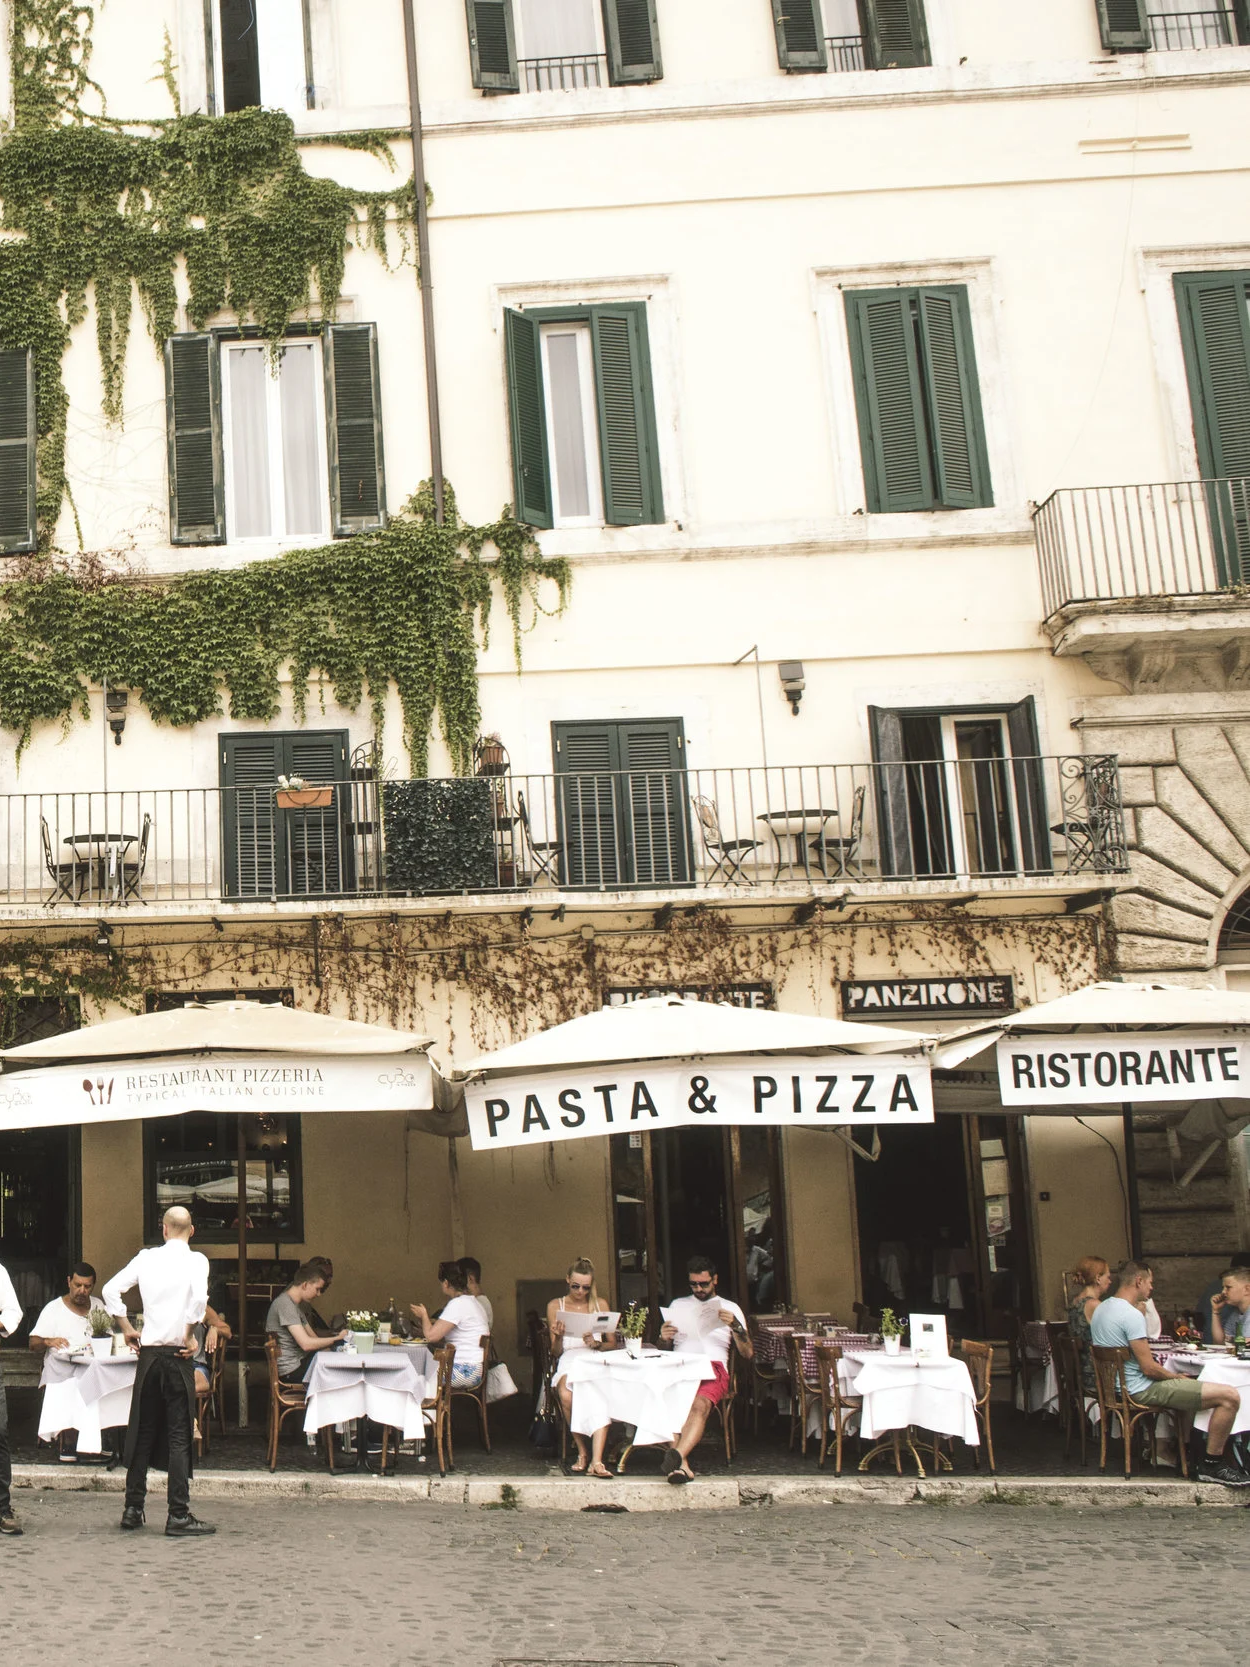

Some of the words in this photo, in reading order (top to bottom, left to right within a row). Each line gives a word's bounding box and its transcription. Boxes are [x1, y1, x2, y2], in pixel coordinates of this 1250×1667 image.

[848, 981, 1005, 1008] PANZIRONE
[126, 1068, 237, 1090] RESTAURANT
[243, 1067, 324, 1083] PIZZERIA
[1011, 1046, 1240, 1089] RISTORANTE
[128, 1089, 187, 1103] TYPICAL
[194, 1086, 253, 1096] ITALIAN
[262, 1086, 324, 1096] CUISINE
[483, 1080, 659, 1138] PASTA
[687, 1075, 718, 1114] &
[753, 1073, 919, 1114] PIZZA
